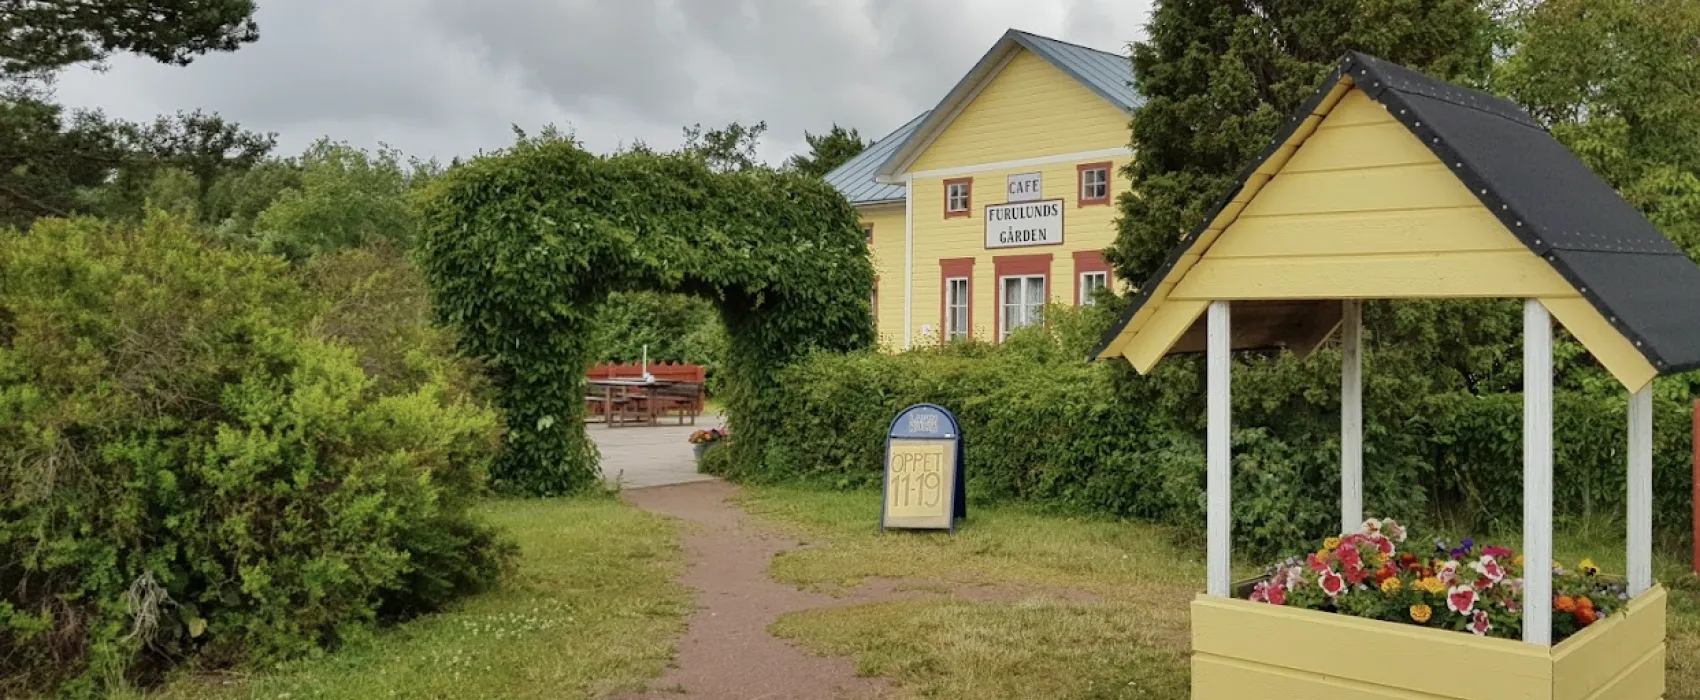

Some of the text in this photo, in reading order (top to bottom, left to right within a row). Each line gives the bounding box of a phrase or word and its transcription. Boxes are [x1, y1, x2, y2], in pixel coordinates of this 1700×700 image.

[1009, 179, 1039, 194] CAFE
[989, 203, 1058, 221] FURULUNDS
[1000, 226, 1047, 243] GÅRDEN
[891, 451, 942, 473] ÖPPET
[891, 472, 940, 508] 11-19
